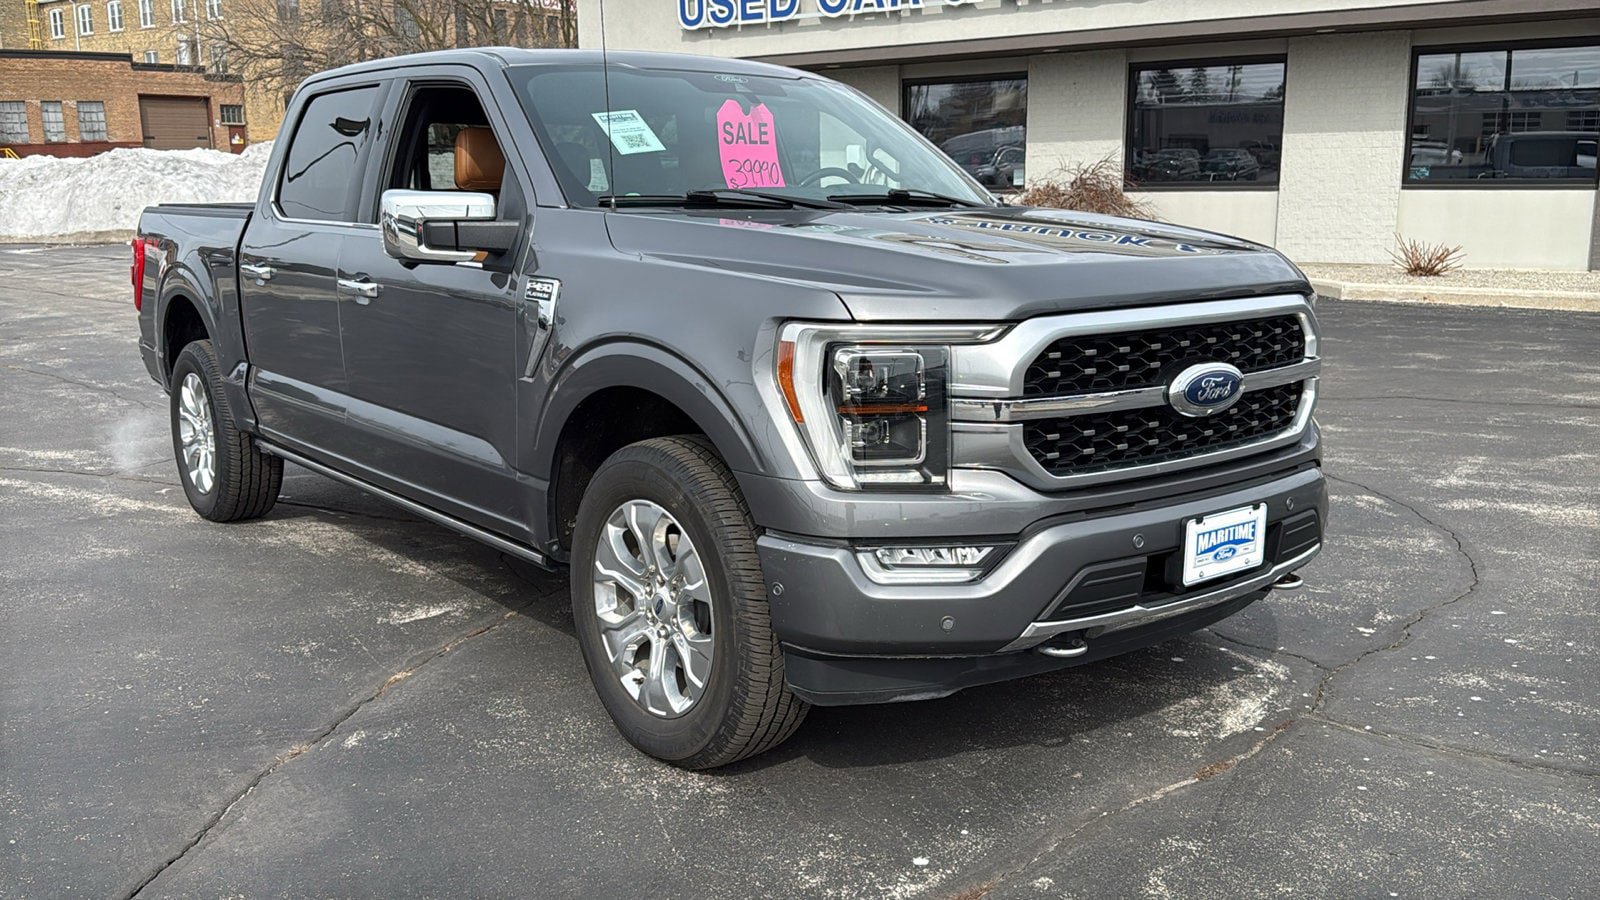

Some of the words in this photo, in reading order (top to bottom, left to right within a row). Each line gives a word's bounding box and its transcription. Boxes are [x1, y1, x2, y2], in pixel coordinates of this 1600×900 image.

[722, 121, 770, 145] SALE
[1197, 376, 1232, 401] Ford
[1197, 522, 1255, 553] MARITIME
